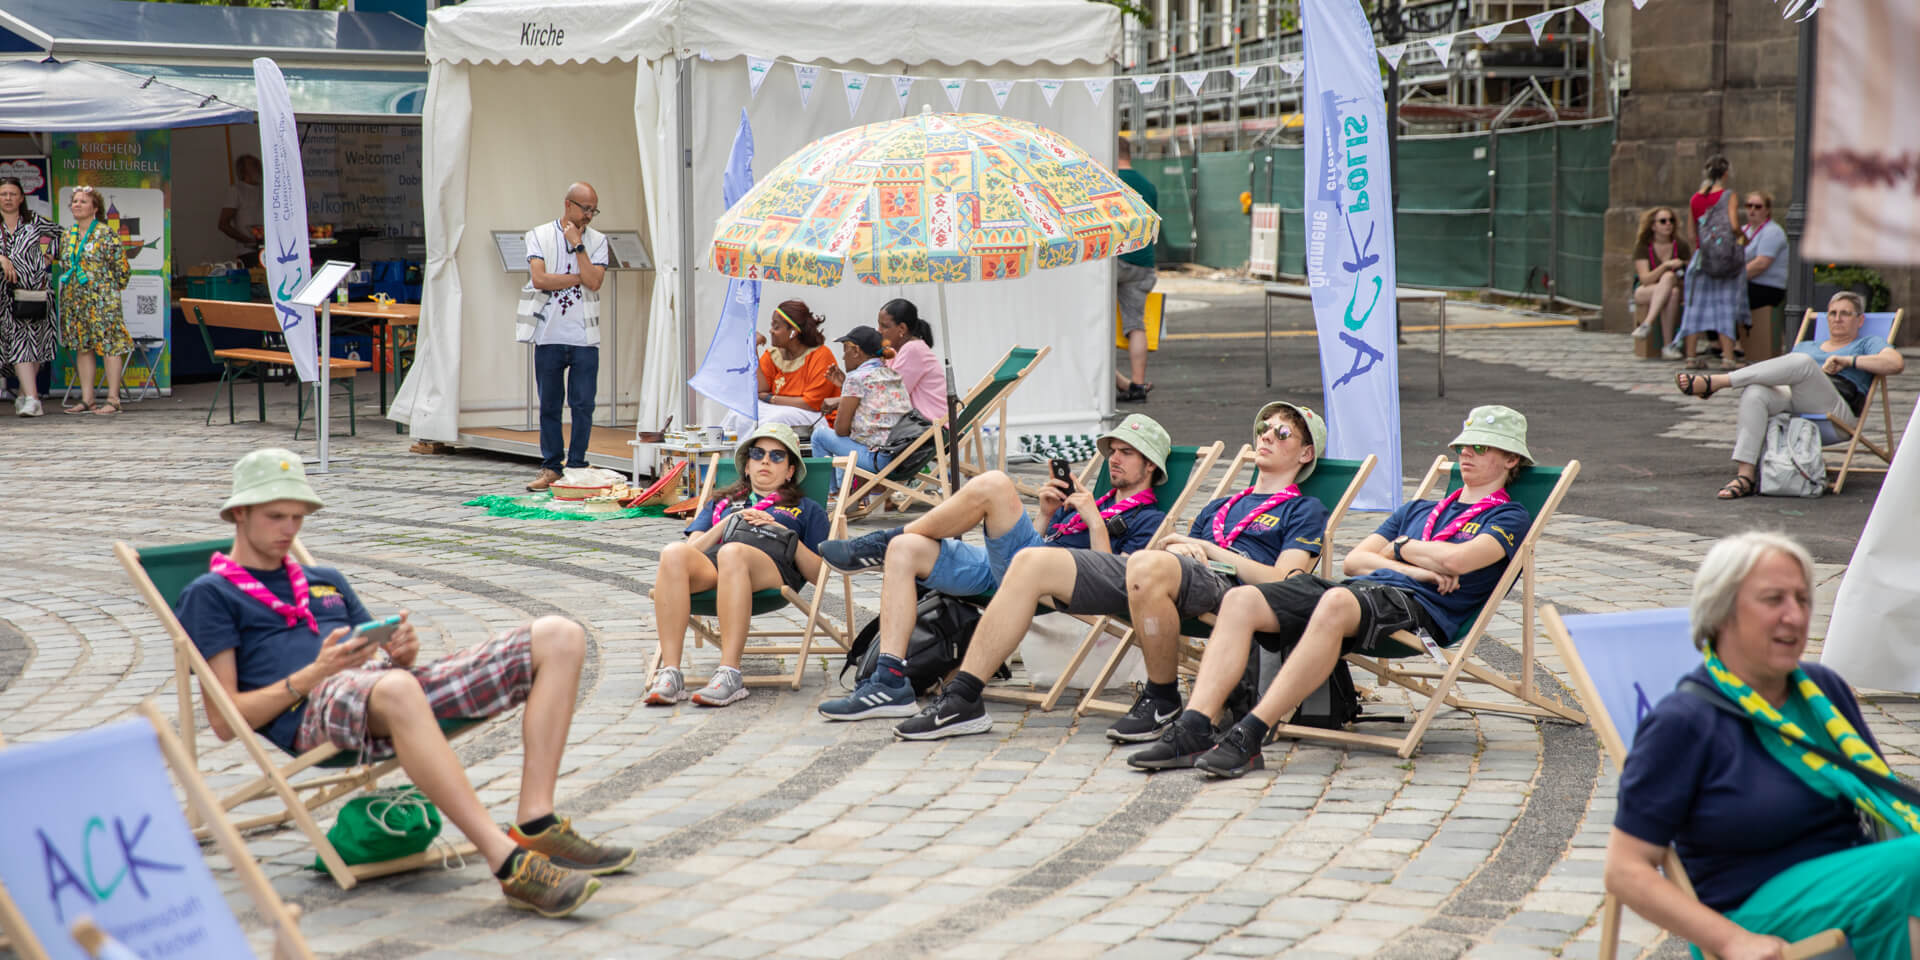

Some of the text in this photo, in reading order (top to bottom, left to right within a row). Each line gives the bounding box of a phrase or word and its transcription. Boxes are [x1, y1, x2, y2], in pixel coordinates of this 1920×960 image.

[520, 22, 565, 46] Kirche
[81, 143, 142, 156] KIRCHE(N)
[345, 151, 406, 165] Welcome!
[63, 159, 160, 172] INTERKULTURELL
[36, 814, 185, 924] ACK
